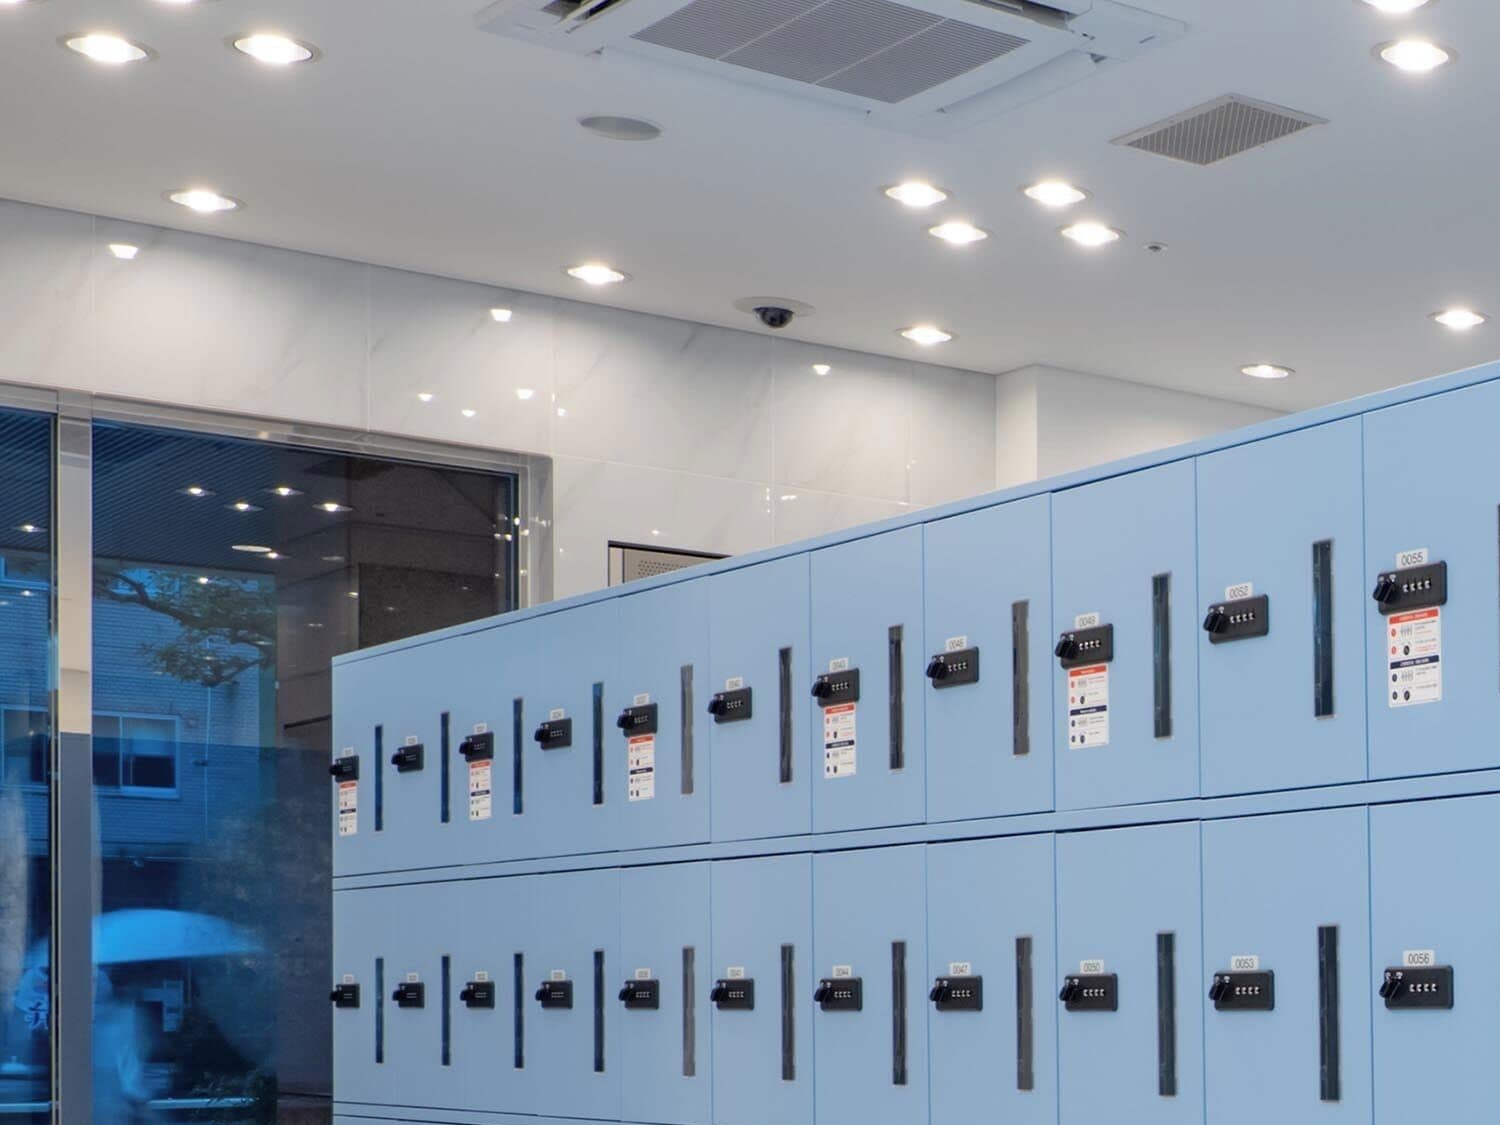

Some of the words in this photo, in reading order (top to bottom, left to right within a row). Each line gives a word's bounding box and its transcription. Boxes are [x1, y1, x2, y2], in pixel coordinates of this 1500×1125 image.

[1401, 551, 1423, 566] 0055
[1235, 958, 1254, 968] 0053
[1408, 953, 1429, 964] 0056
